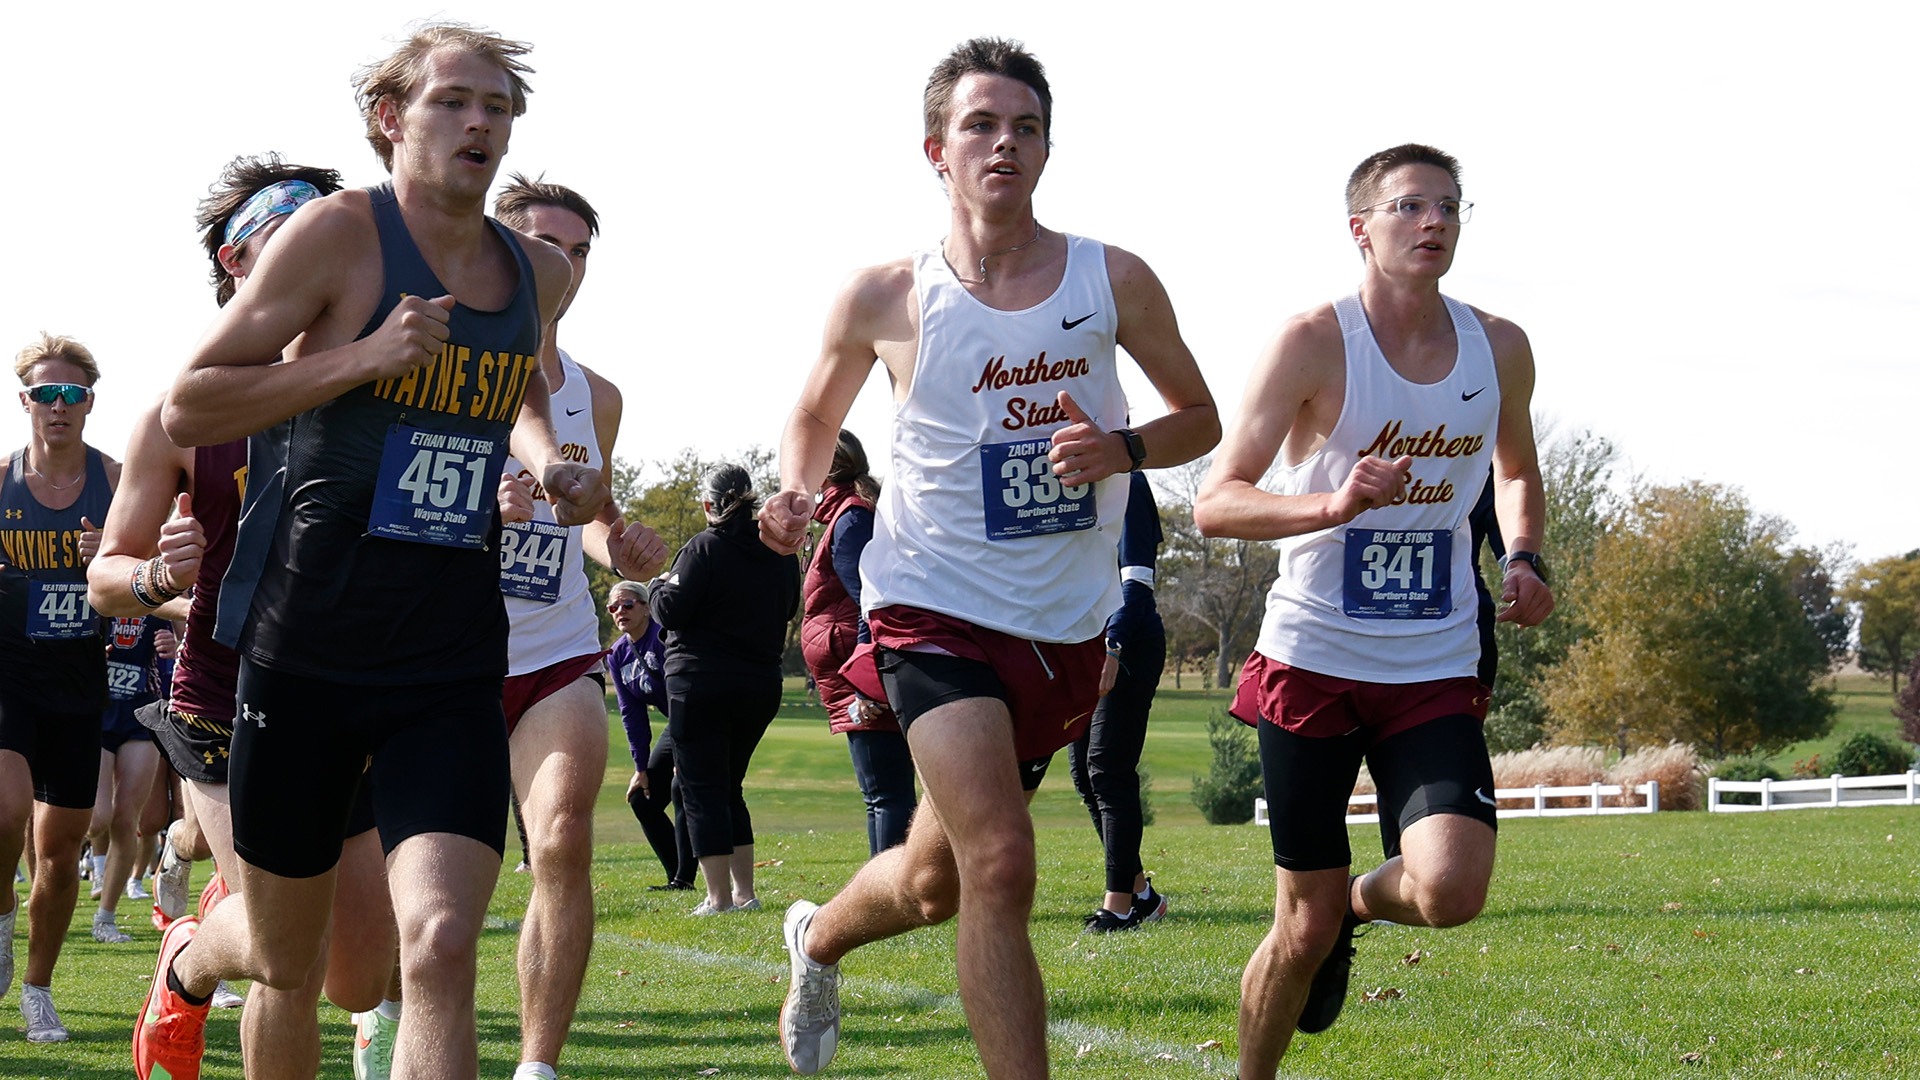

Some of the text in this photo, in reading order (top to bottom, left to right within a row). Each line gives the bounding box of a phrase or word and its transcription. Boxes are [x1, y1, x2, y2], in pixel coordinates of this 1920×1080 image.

[972, 351, 1090, 393] Northern
[410, 431, 494, 455] ETHAN WALTERS
[1358, 419, 1484, 458] Northern
[1008, 441, 1052, 457] ZACH PA
[397, 449, 487, 511] 451
[413, 508, 468, 524] Wayne State
[1017, 503, 1080, 518] Northern State
[533, 523, 569, 537] THORSON
[1372, 532, 1434, 543] BLAKE STOKS
[0, 530, 58, 571] WAYNE
[500, 529, 564, 577] 344
[1361, 544, 1434, 590] 341
[501, 571, 549, 586] Northern State
[41, 584, 69, 592] KEATON
[1372, 591, 1429, 600] Northern State
[38, 593, 91, 620] 441
[113, 624, 144, 637] MARY
